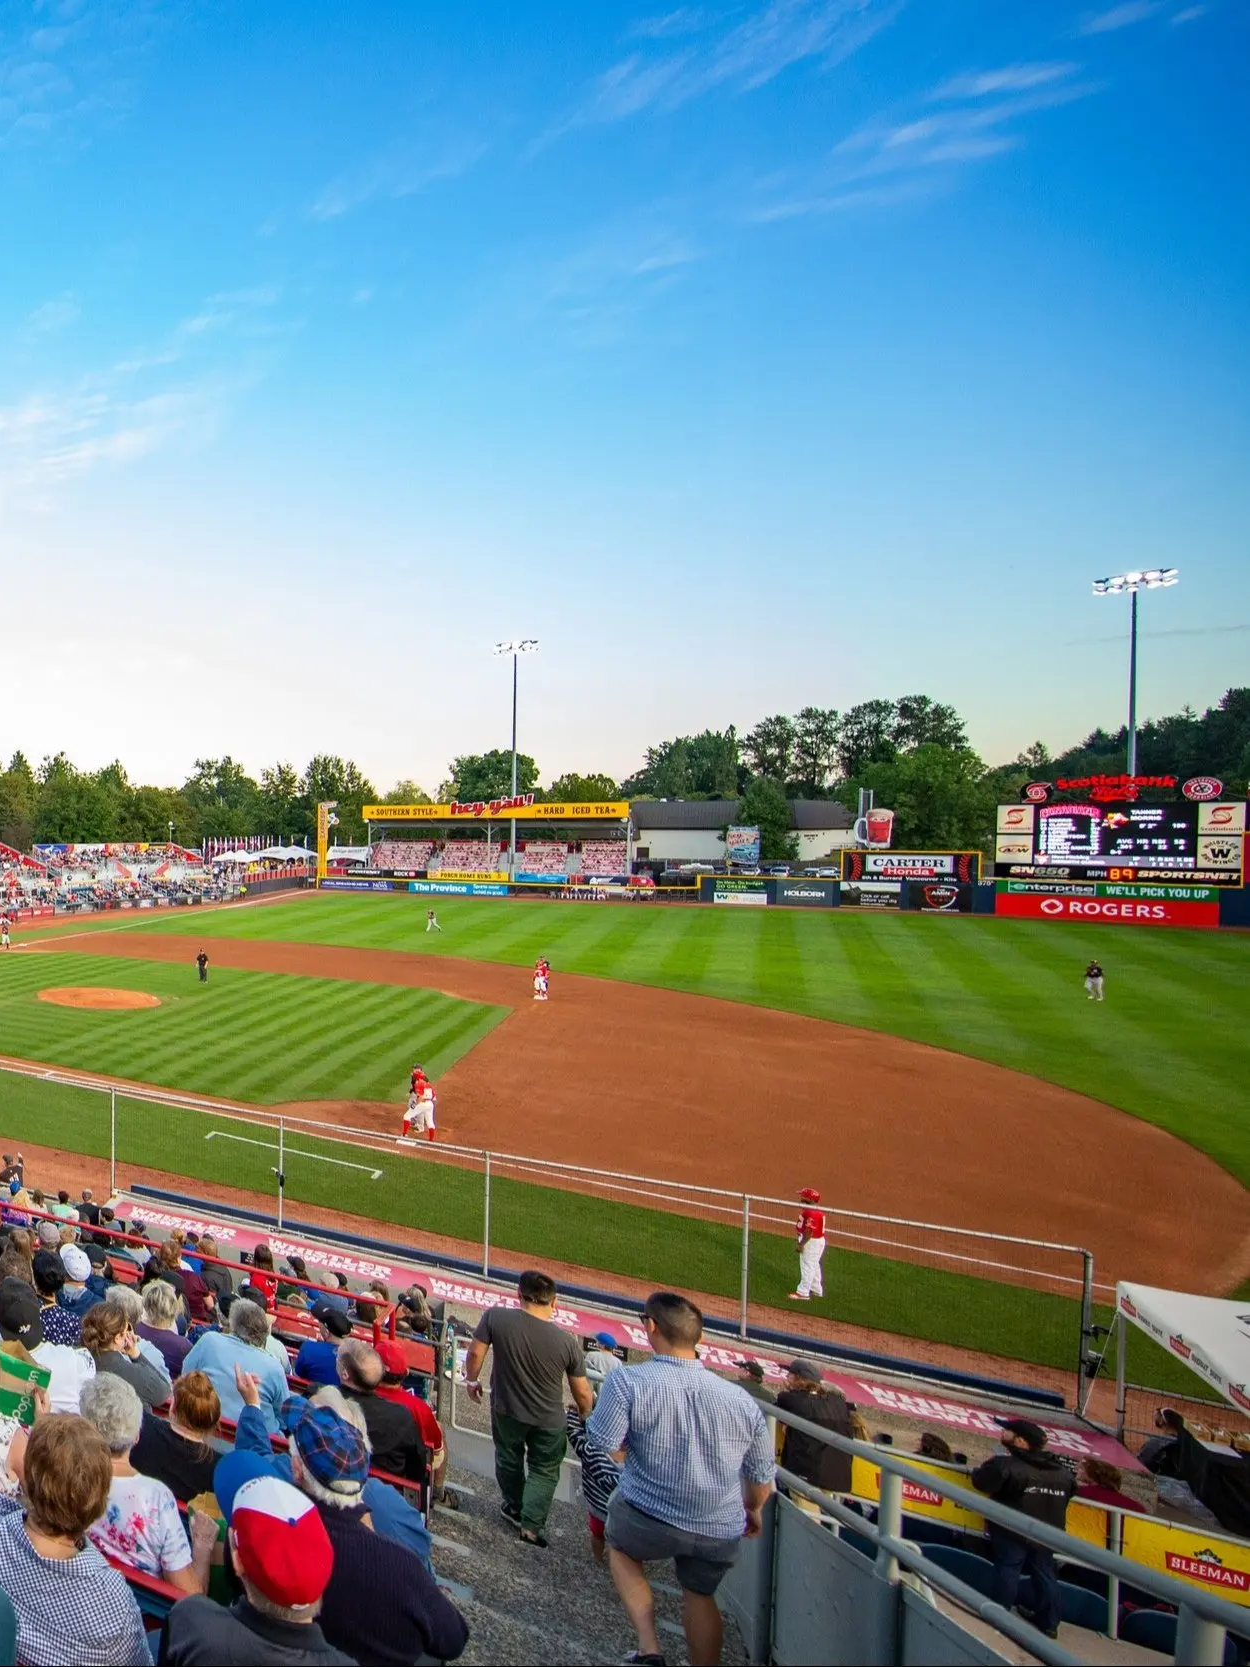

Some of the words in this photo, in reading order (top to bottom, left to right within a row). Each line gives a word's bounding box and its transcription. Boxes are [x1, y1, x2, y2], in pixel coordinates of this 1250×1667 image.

[1056, 774, 1178, 790] Scotiabank
[413, 808, 434, 816] STYLE
[450, 800, 486, 817] hey
[489, 793, 534, 816] y'all!
[572, 806, 591, 814] ICED
[594, 806, 610, 814] TEA
[1210, 849, 1231, 859] W
[873, 858, 946, 868] CARTER
[1087, 870, 1107, 878] MPH
[1110, 868, 1133, 880] 89
[1137, 871, 1241, 881] SPORTSNET
[414, 883, 429, 891] The
[430, 883, 467, 893] Province
[1013, 883, 1094, 894] enterprise
[1106, 885, 1137, 896] WE'LL
[1140, 887, 1166, 897] PICK
[1167, 888, 1191, 898] YOU
[1194, 889, 1210, 899] UP
[1069, 901, 1166, 918] ROGERS
[131, 1206, 237, 1237] WHISTLER
[268, 1238, 392, 1275] WHISTLER
[429, 1277, 580, 1322] WHISTER
[856, 1382, 1093, 1447] WHISTER
[903, 1484, 939, 1503] EMAN
[1171, 1557, 1244, 1587] SLEEMAN
